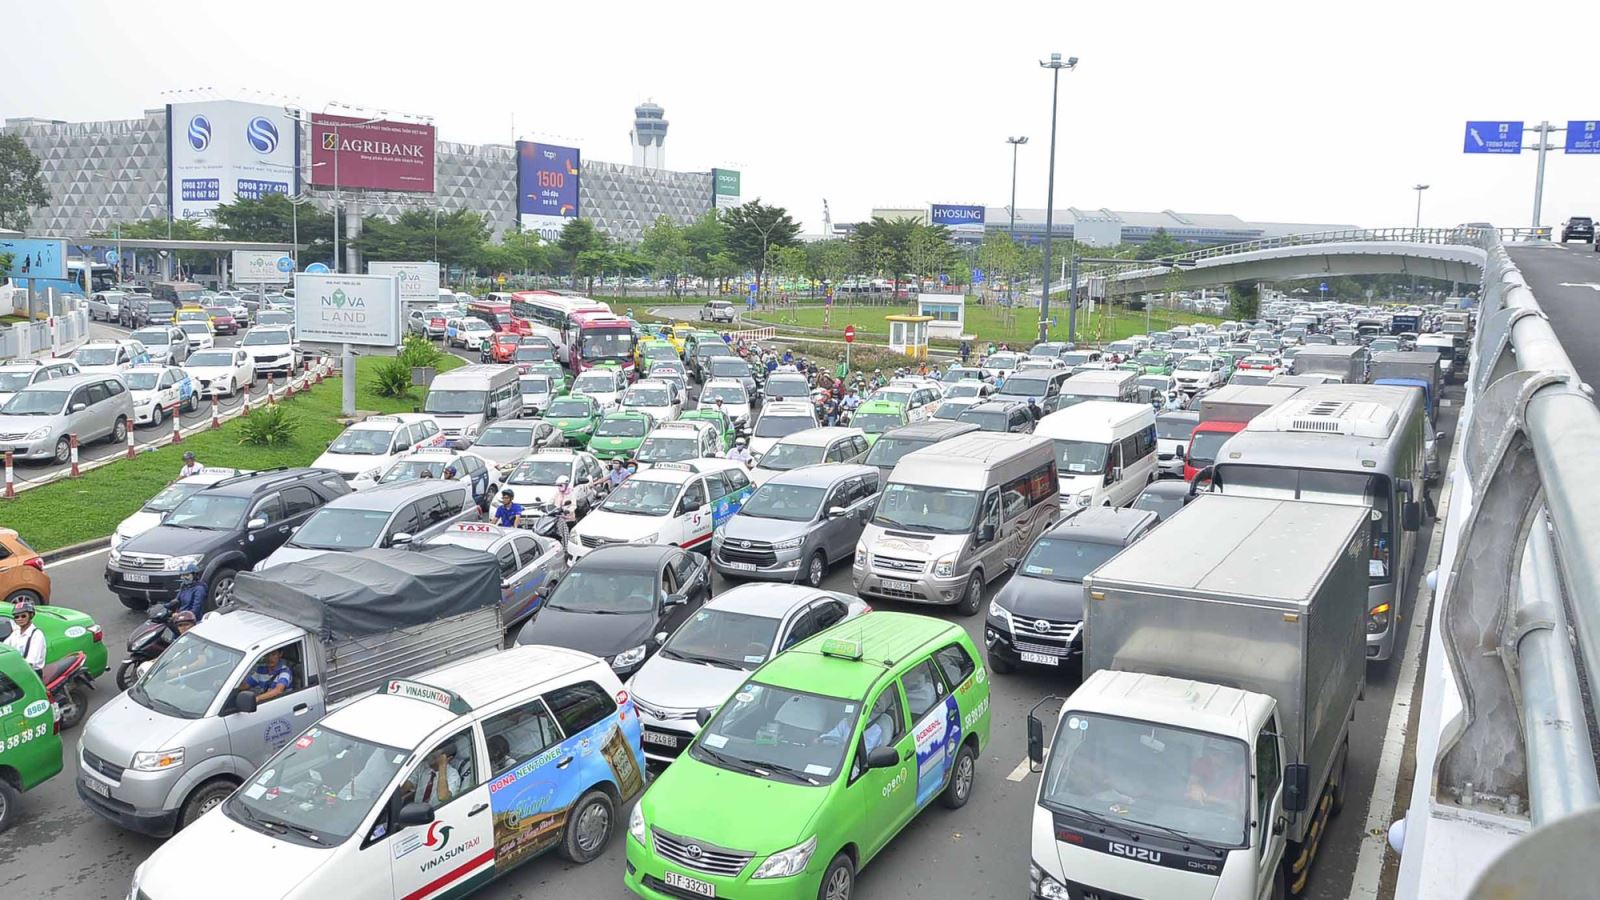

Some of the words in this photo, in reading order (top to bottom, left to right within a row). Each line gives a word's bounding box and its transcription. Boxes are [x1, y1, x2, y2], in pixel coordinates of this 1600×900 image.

[341, 139, 424, 158] AGRIBANK
[536, 169, 564, 188] 1500
[183, 181, 196, 189] 0908
[197, 181, 207, 189] 277
[208, 181, 219, 189] 470
[239, 181, 257, 190] 0908
[259, 182, 272, 191] 277
[274, 184, 287, 193] 470
[239, 191, 257, 200] 0918
[934, 208, 981, 220] HYOSUNG
[321, 290, 366, 308] NOVA
[321, 311, 366, 323] LAND
[458, 524, 490, 533] TAXI
[7, 734, 20, 750] 38
[21, 728, 34, 744] 38
[35, 722, 47, 738] 38
[490, 773, 517, 793] DONA
[1109, 841, 1161, 863] ISUZU
[1187, 860, 1218, 872] QKR
